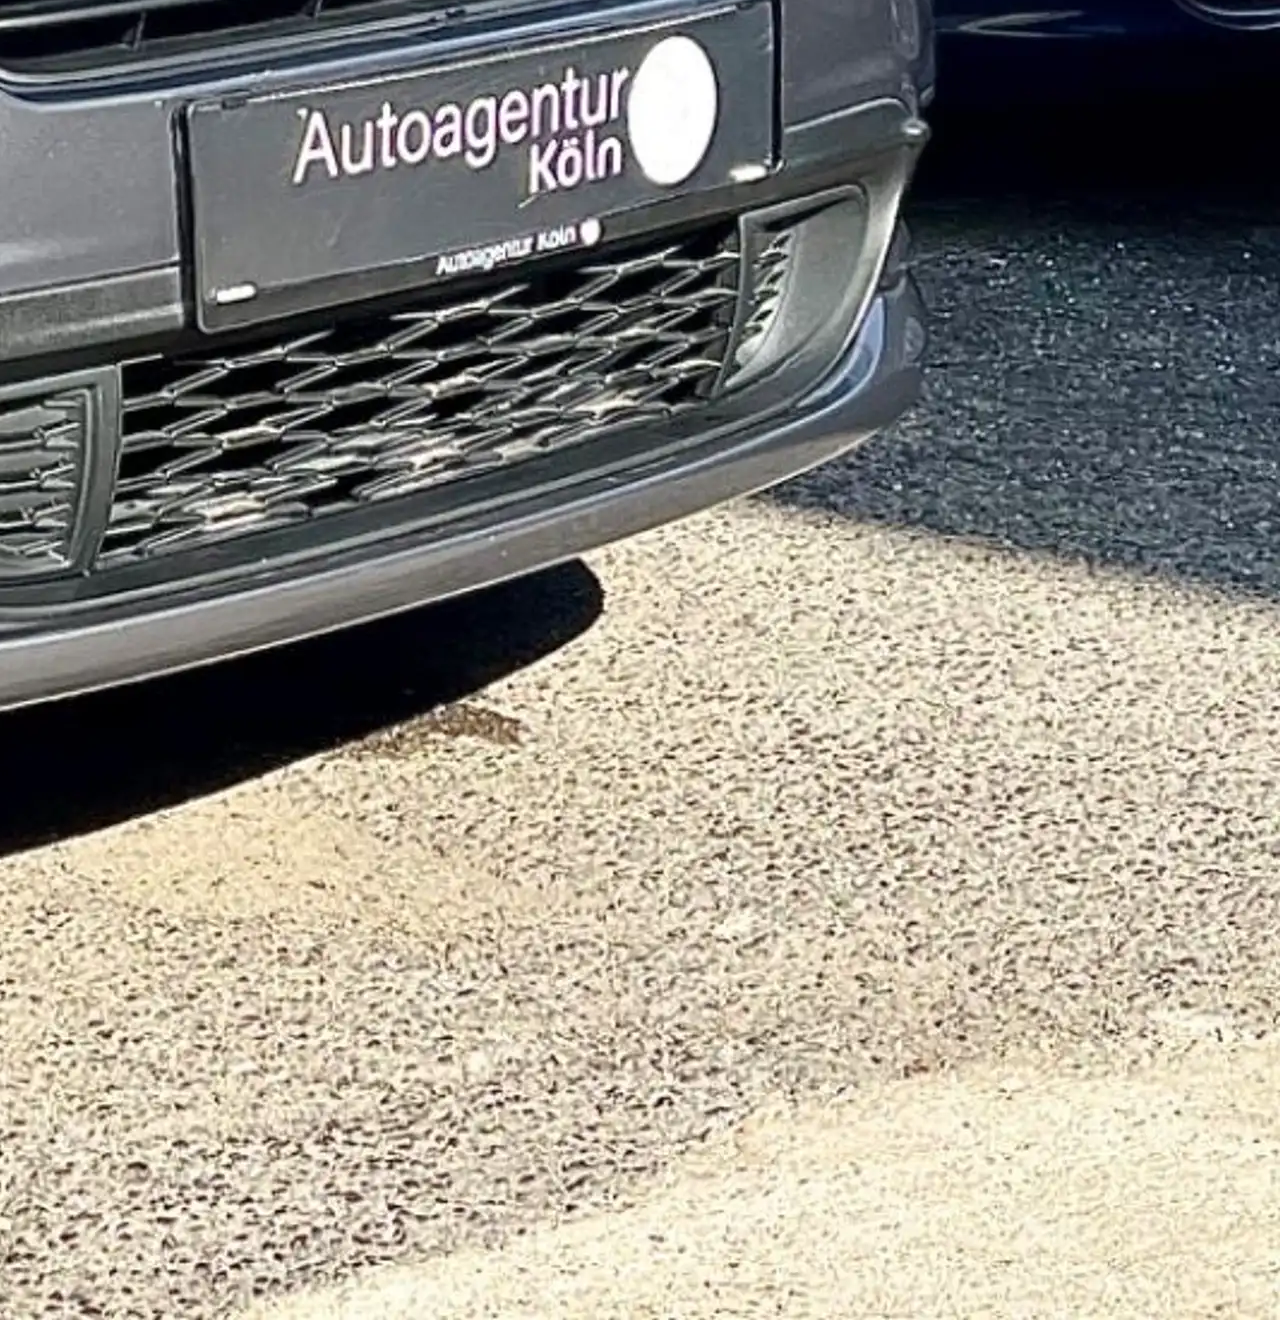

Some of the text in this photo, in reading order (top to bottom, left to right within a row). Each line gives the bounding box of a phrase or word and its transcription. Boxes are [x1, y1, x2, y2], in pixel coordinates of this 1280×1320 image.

[292, 67, 628, 184] Autoagentur
[527, 130, 623, 196] Köln
[435, 236, 534, 276] Autoagentur
